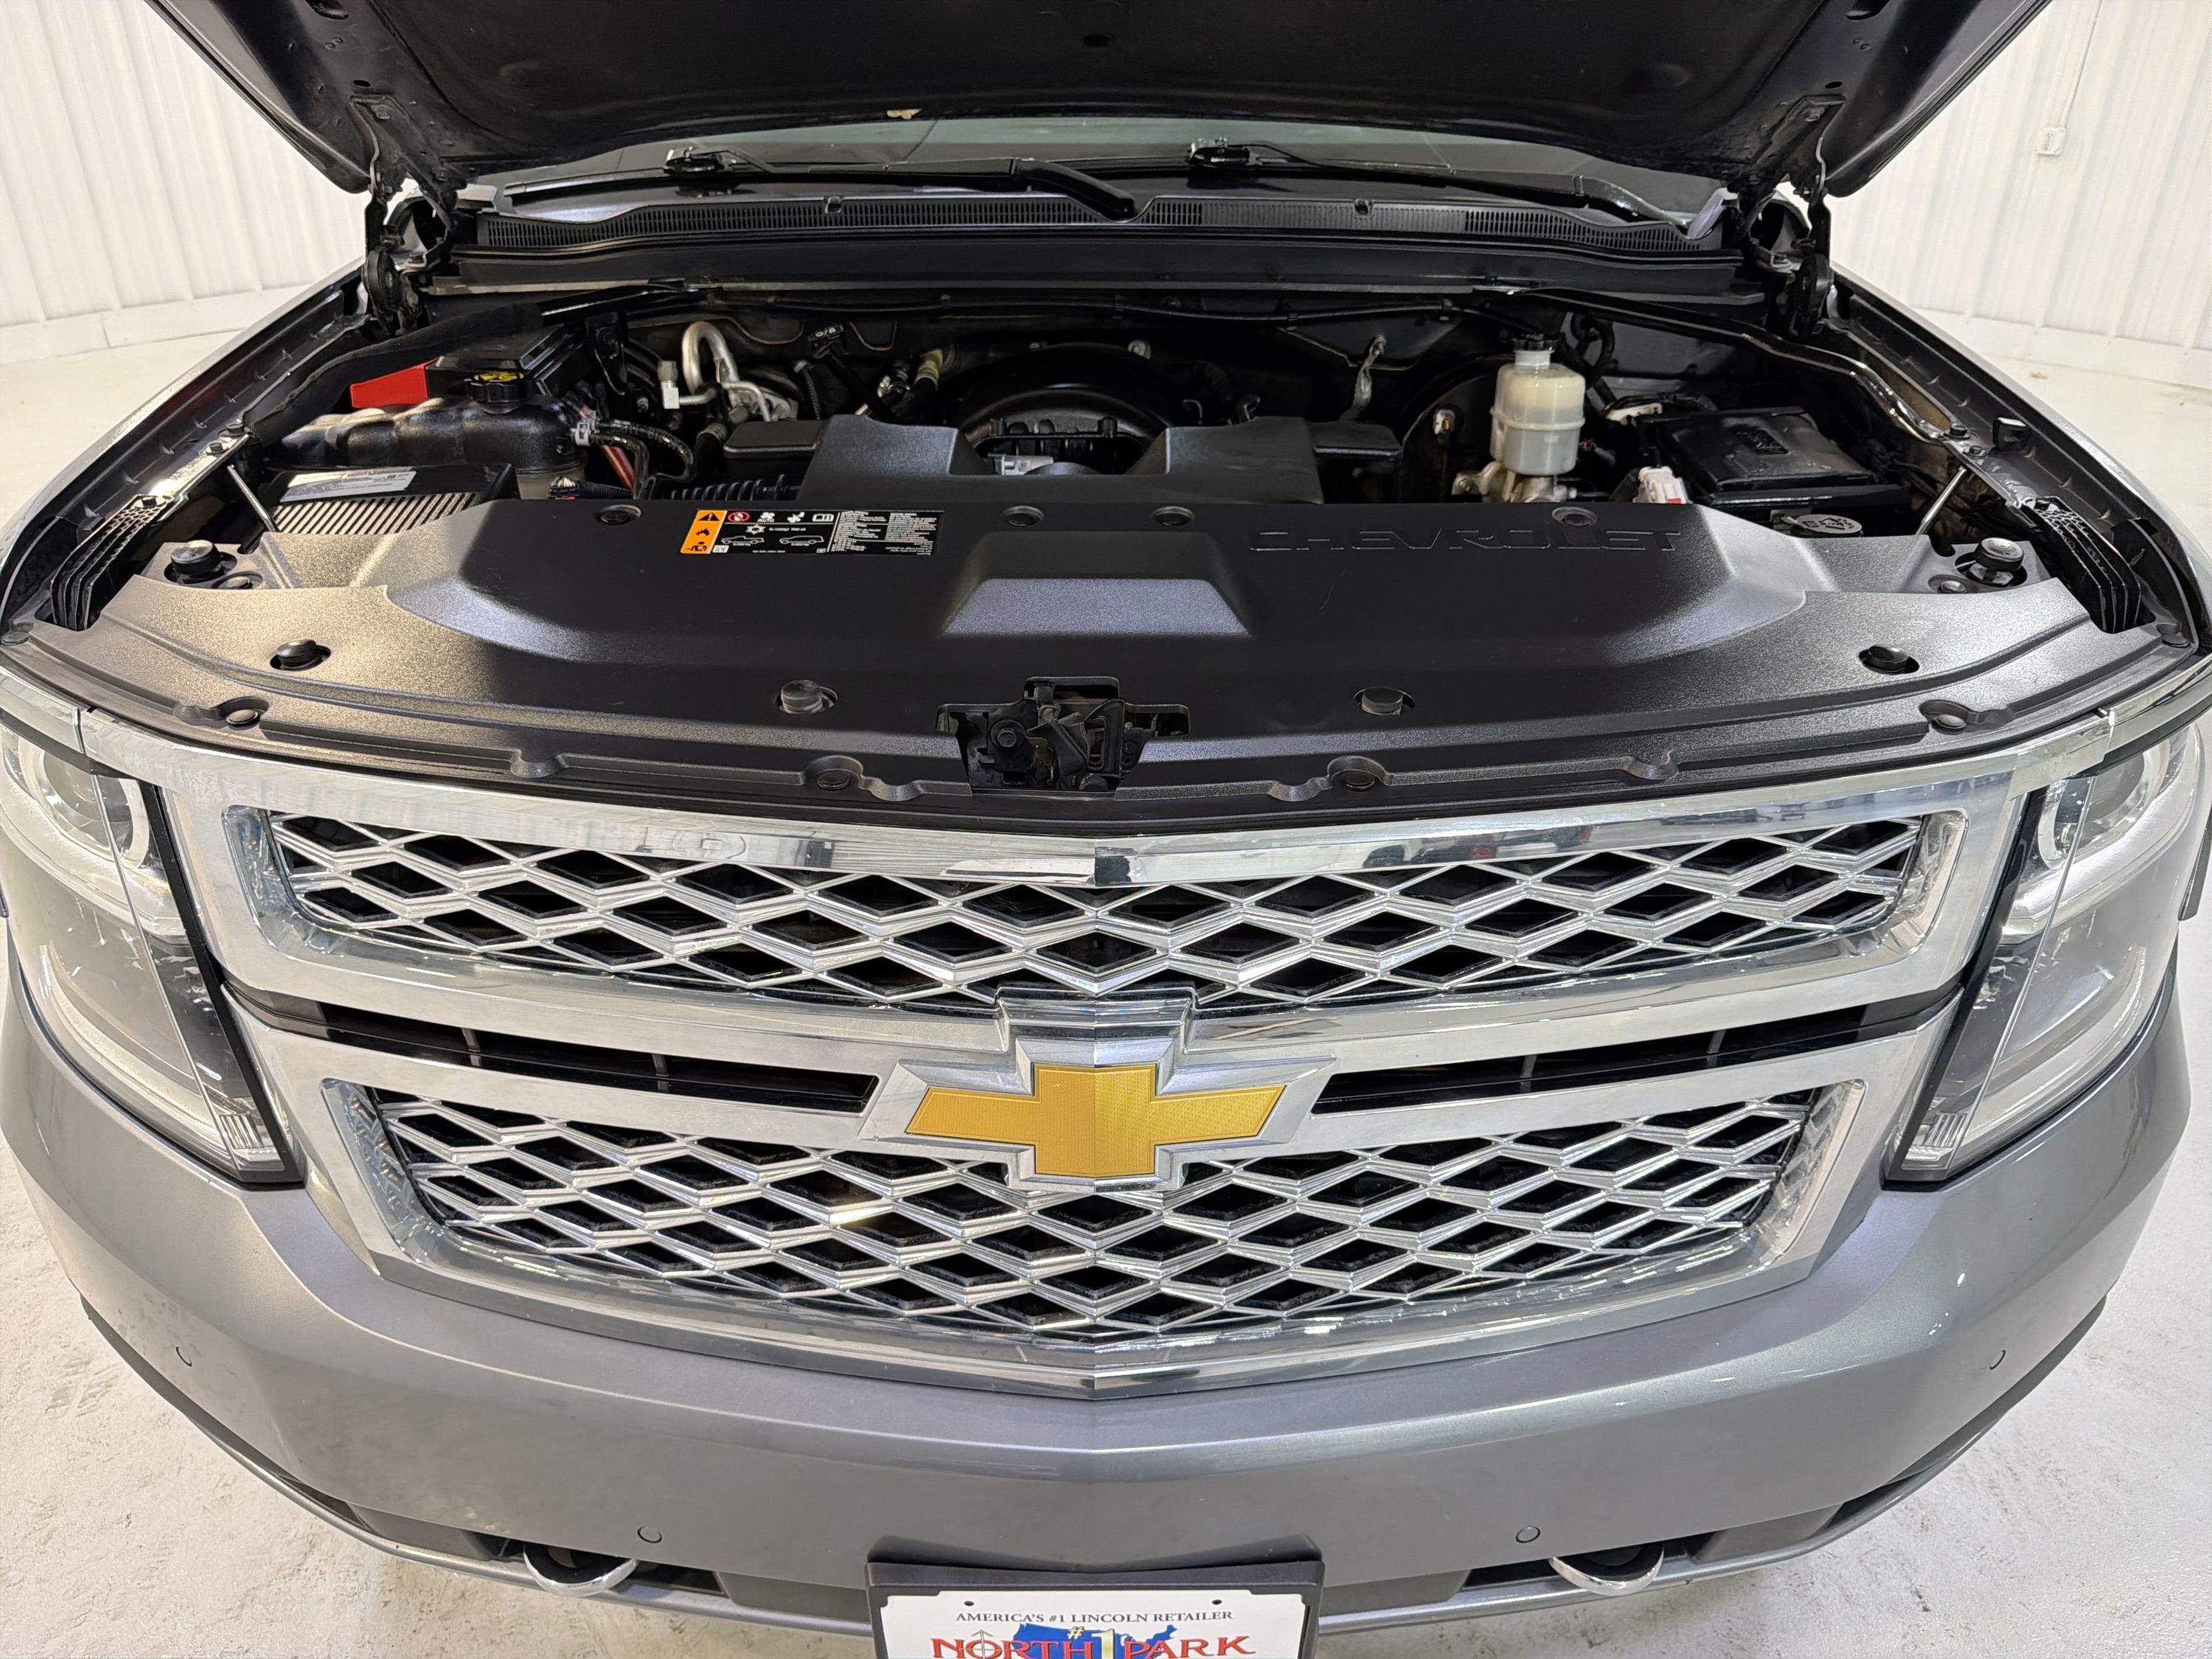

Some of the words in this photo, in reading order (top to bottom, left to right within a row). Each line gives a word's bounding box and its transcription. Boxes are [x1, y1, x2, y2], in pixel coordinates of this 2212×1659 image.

[1251, 529, 1680, 550] CHEVROLET
[956, 1613, 1045, 1622] AMERICA'S
[1071, 1613, 1147, 1623] LINCOLN
[1154, 1611, 1233, 1621] RETAILER
[931, 1638, 1093, 1659] NORTH
[1124, 1635, 1256, 1659] PARK
